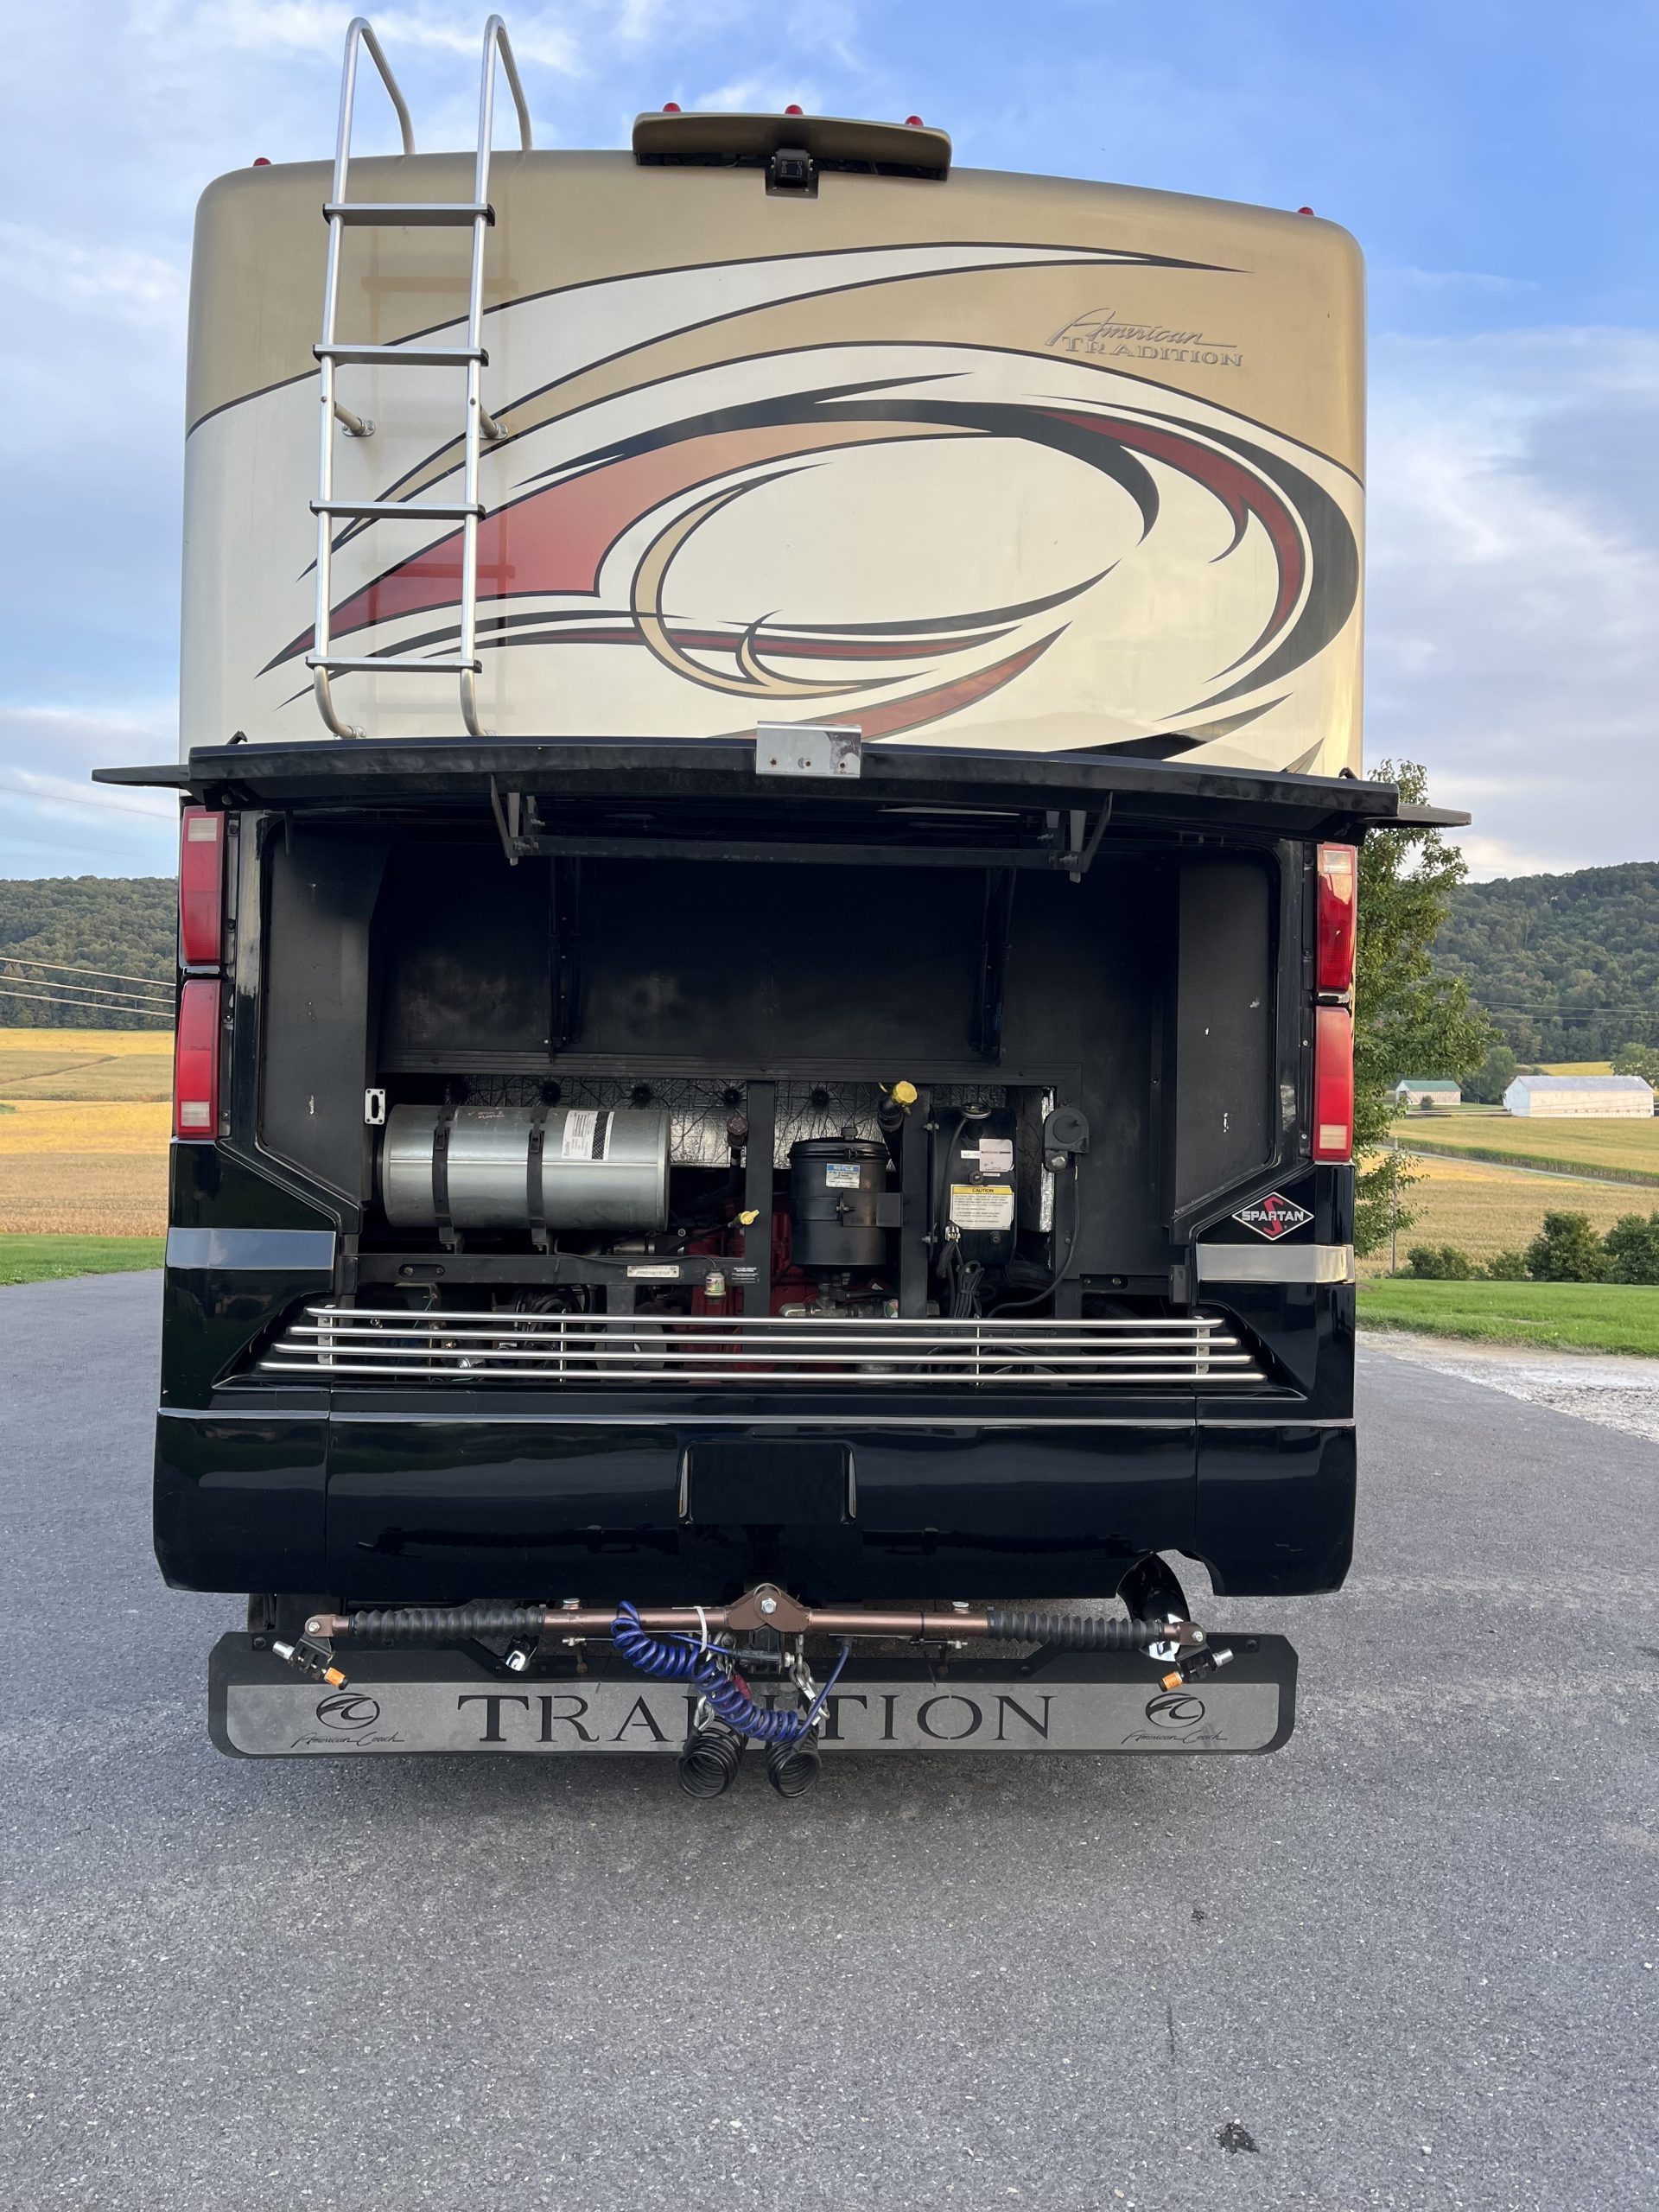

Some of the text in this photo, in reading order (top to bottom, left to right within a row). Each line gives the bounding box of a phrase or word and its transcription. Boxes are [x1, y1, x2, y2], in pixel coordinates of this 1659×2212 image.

[1044, 307, 1237, 348] American
[1061, 335, 1244, 367] TRADITION
[1242, 1211, 1304, 1221] SPARTAN
[457, 1694, 1058, 1743] TRATION
[290, 1732, 357, 1749] American
[1121, 1729, 1183, 1745] American
